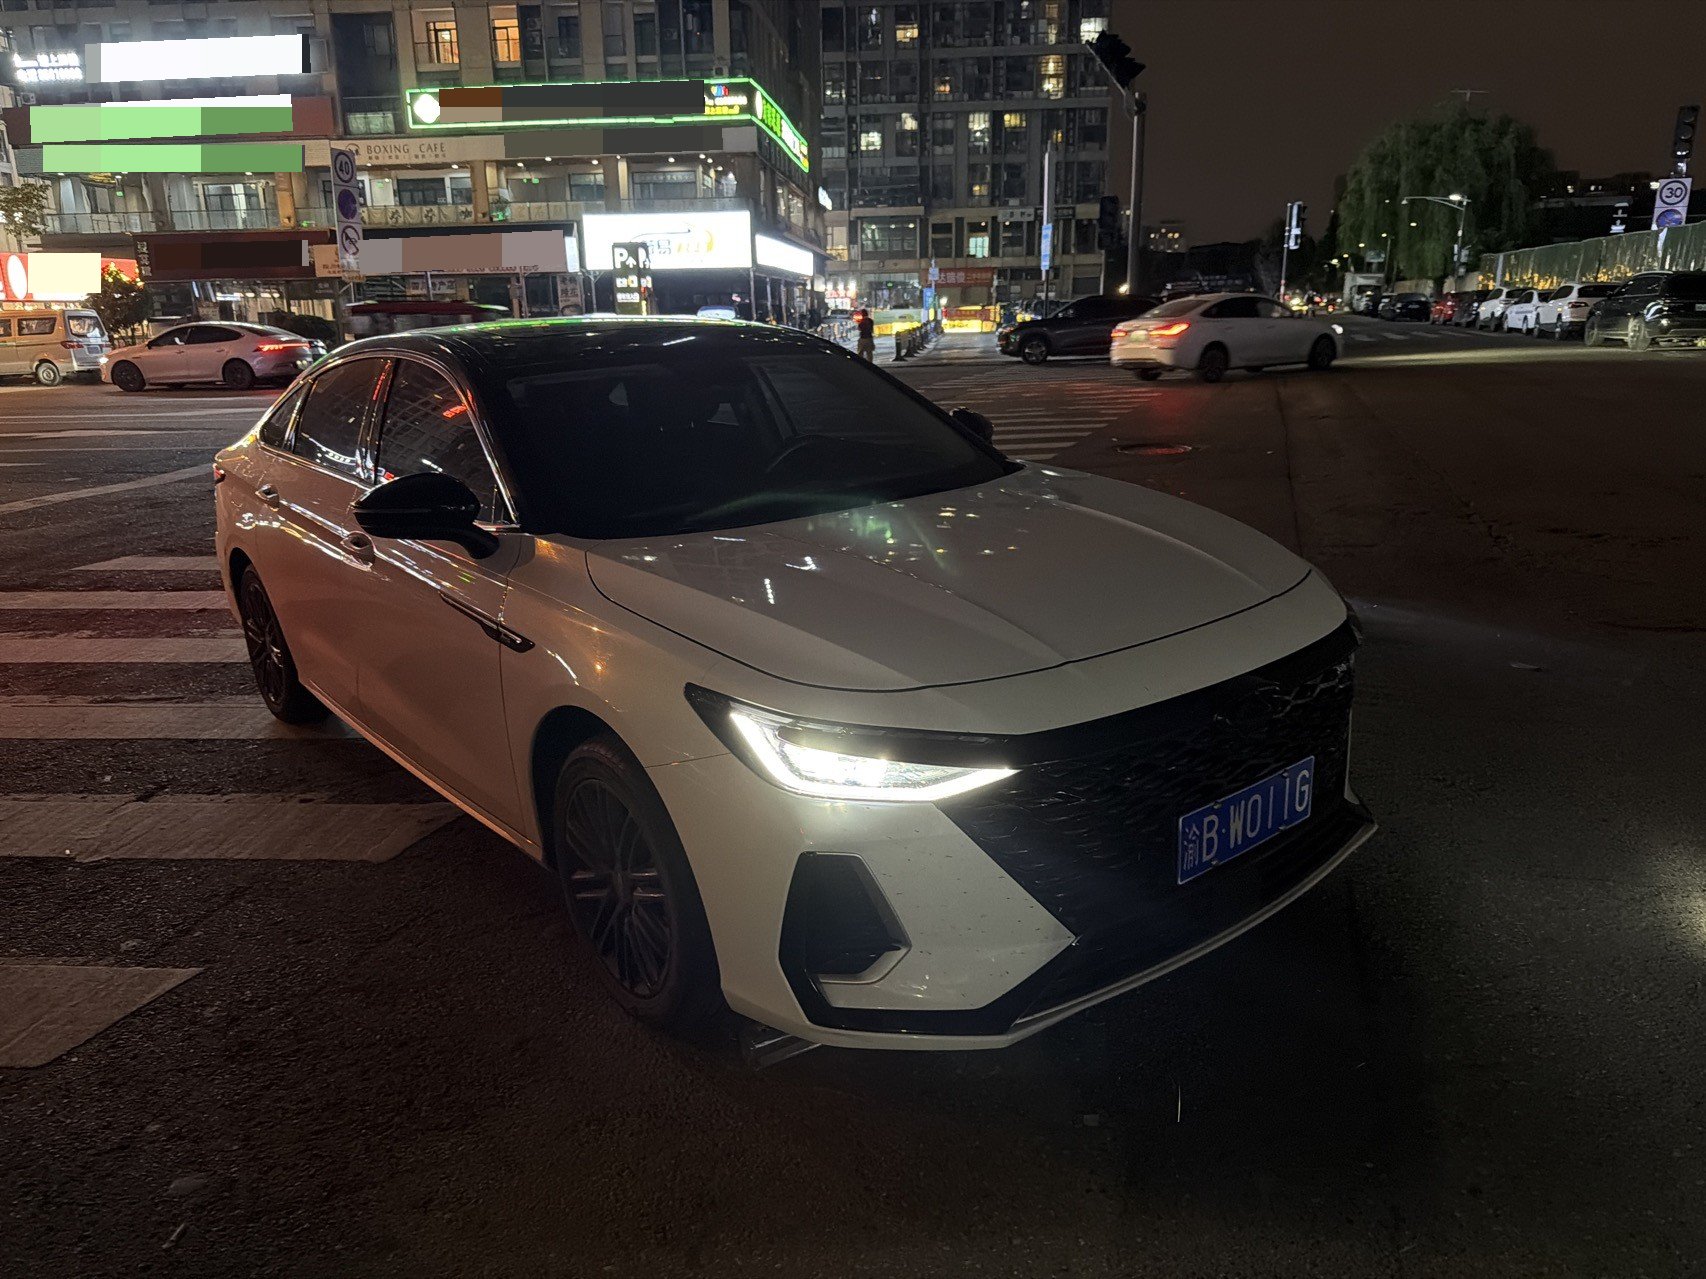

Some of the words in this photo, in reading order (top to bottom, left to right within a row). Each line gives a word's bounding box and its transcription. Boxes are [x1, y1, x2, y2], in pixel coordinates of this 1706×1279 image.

[366, 144, 410, 155] BOXING
[338, 160, 350, 175] 40
[1665, 187, 1683, 198] 30
[613, 246, 629, 269] P
